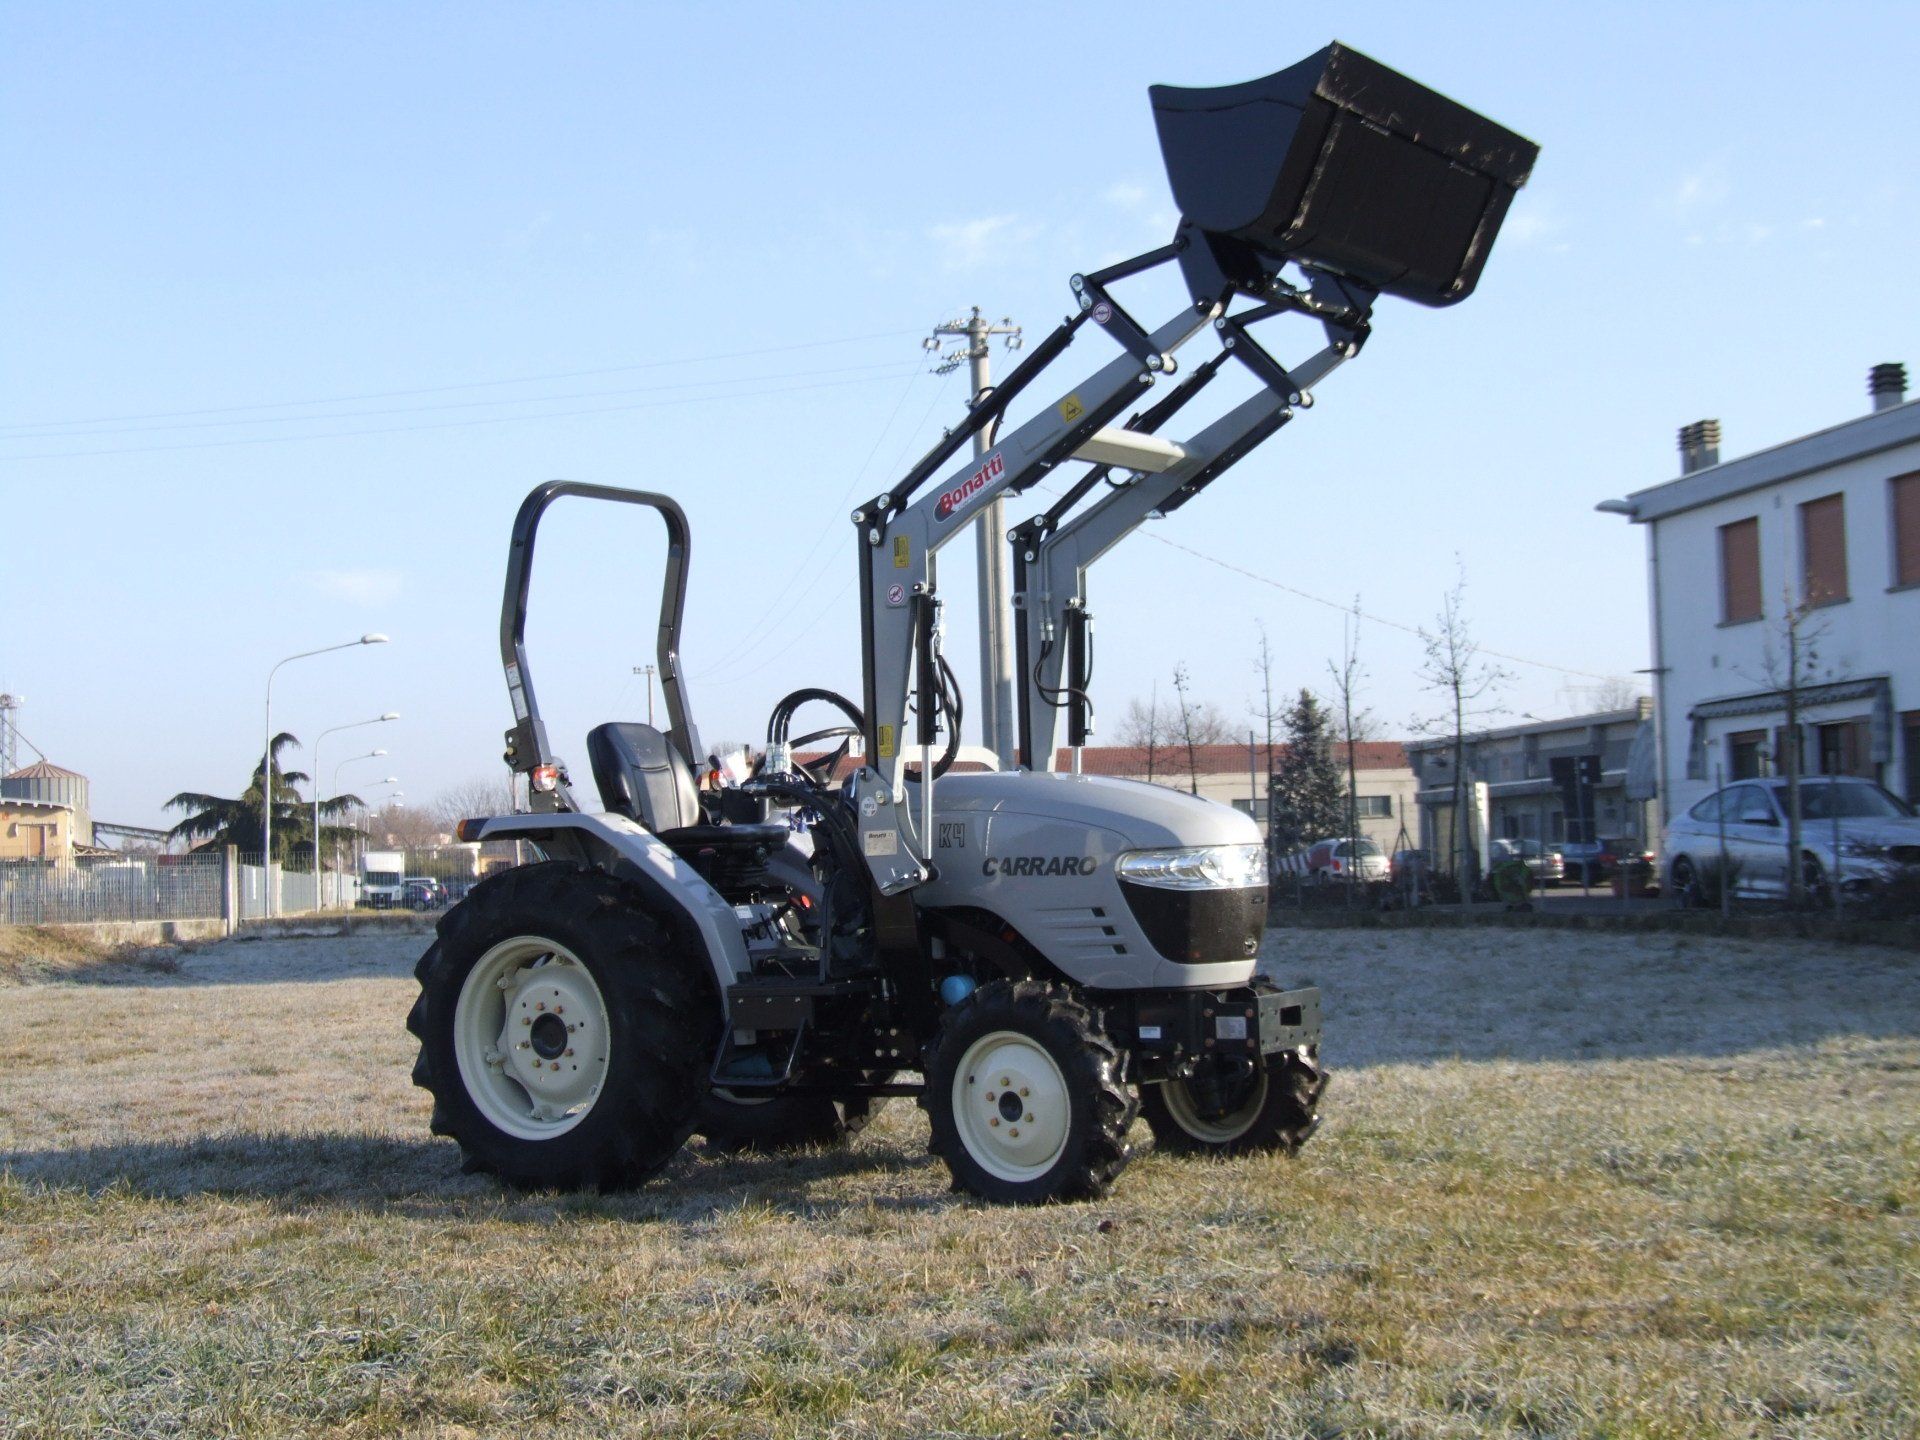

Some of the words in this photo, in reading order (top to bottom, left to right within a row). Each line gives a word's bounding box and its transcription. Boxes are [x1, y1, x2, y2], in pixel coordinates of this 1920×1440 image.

[940, 453, 1003, 513] Bonatti
[938, 822, 966, 848] K4
[981, 856, 1097, 877] CARRARO
